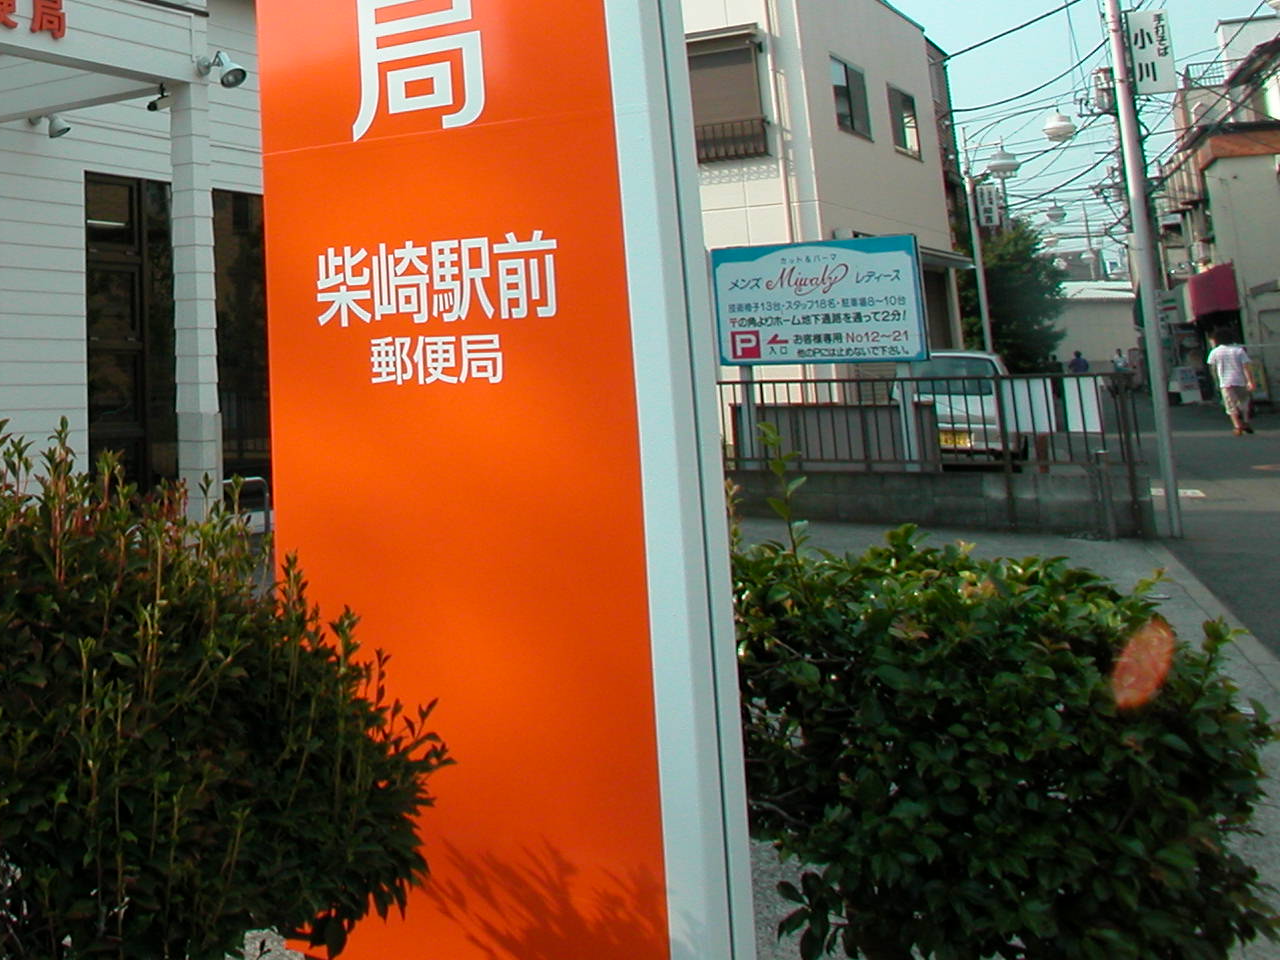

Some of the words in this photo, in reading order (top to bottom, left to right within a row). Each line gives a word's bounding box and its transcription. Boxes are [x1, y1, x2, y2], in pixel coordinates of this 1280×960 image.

[1133, 28, 1157, 82] 小川
[316, 230, 557, 328] 柴崎駅前
[728, 277, 761, 291] メンズ
[856, 269, 901, 284] レディース
[370, 334, 503, 385] 郵便局
